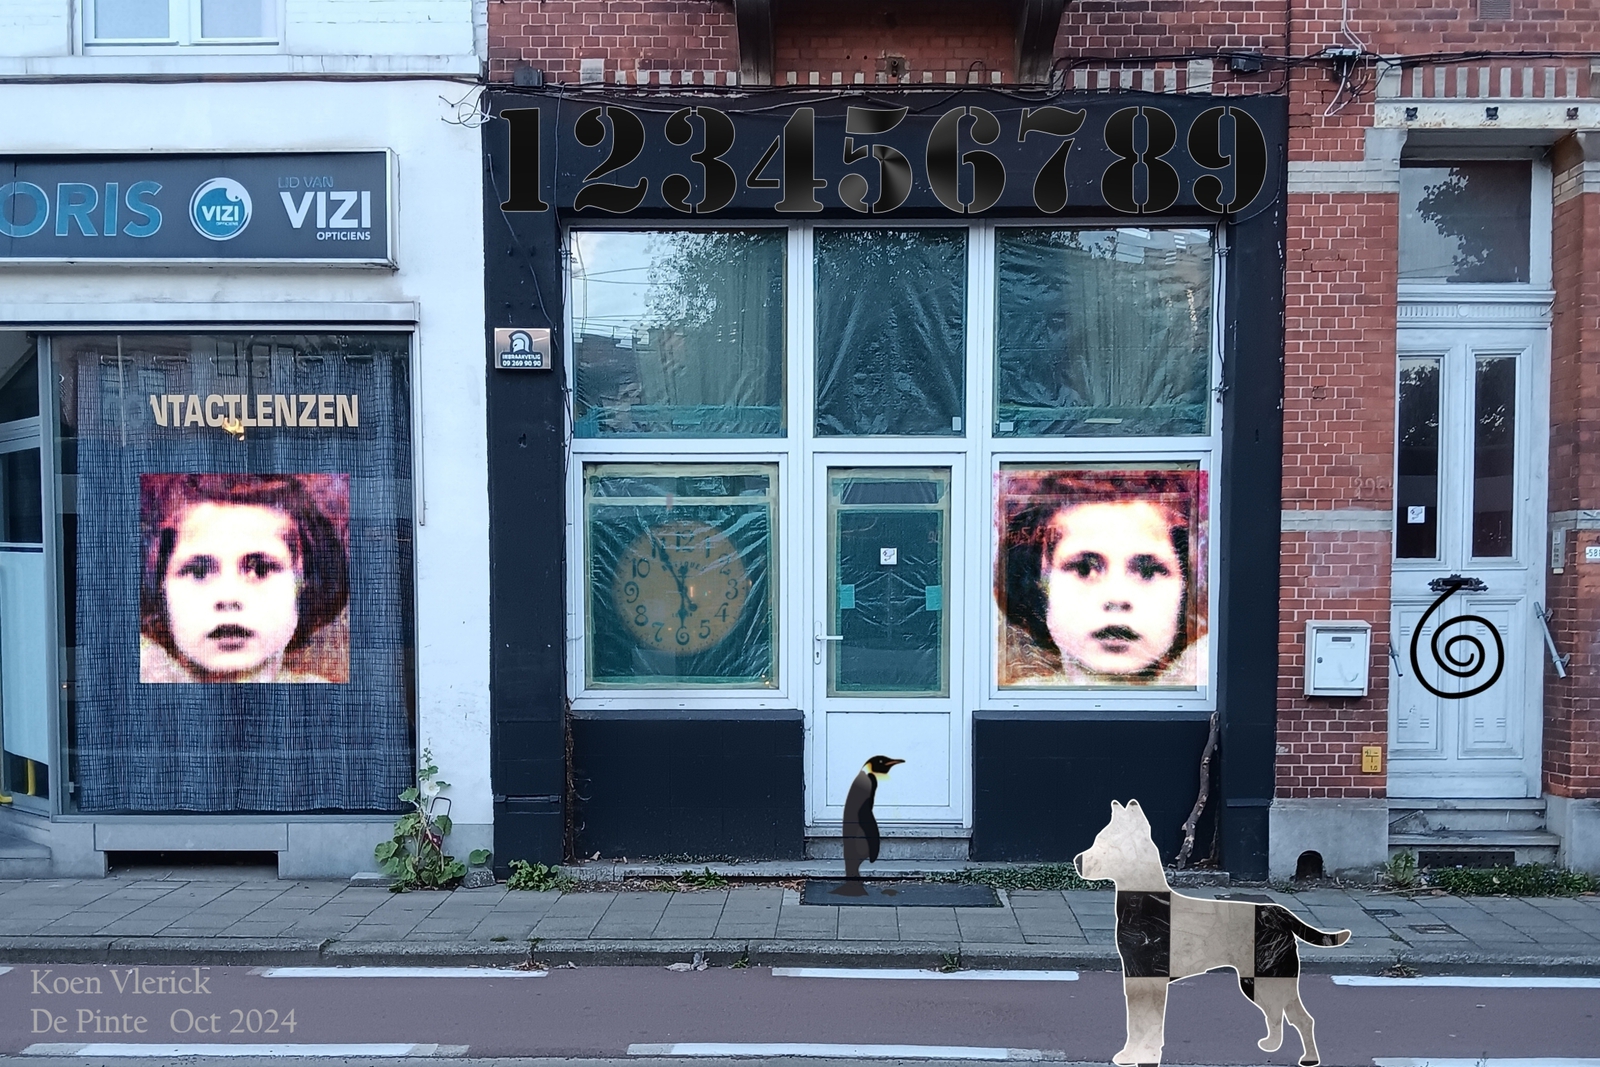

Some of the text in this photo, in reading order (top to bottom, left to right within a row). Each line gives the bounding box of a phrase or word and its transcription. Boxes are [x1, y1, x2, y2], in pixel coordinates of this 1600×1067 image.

[278, 176, 334, 188] LID VAN
[0, 181, 163, 238] ORIS
[201, 205, 239, 222] VIZI
[279, 191, 371, 229] VIZI
[316, 231, 371, 241] OPTICIENS
[675, 530, 695, 552] 12
[631, 558, 651, 579] 10
[719, 553, 731, 575] 2
[624, 581, 639, 603] 9
[725, 578, 739, 600] 3
[634, 604, 648, 626] 8
[714, 602, 729, 622] 4
[652, 621, 664, 642] 7
[675, 626, 690, 646] 6
[699, 619, 711, 639] 5
